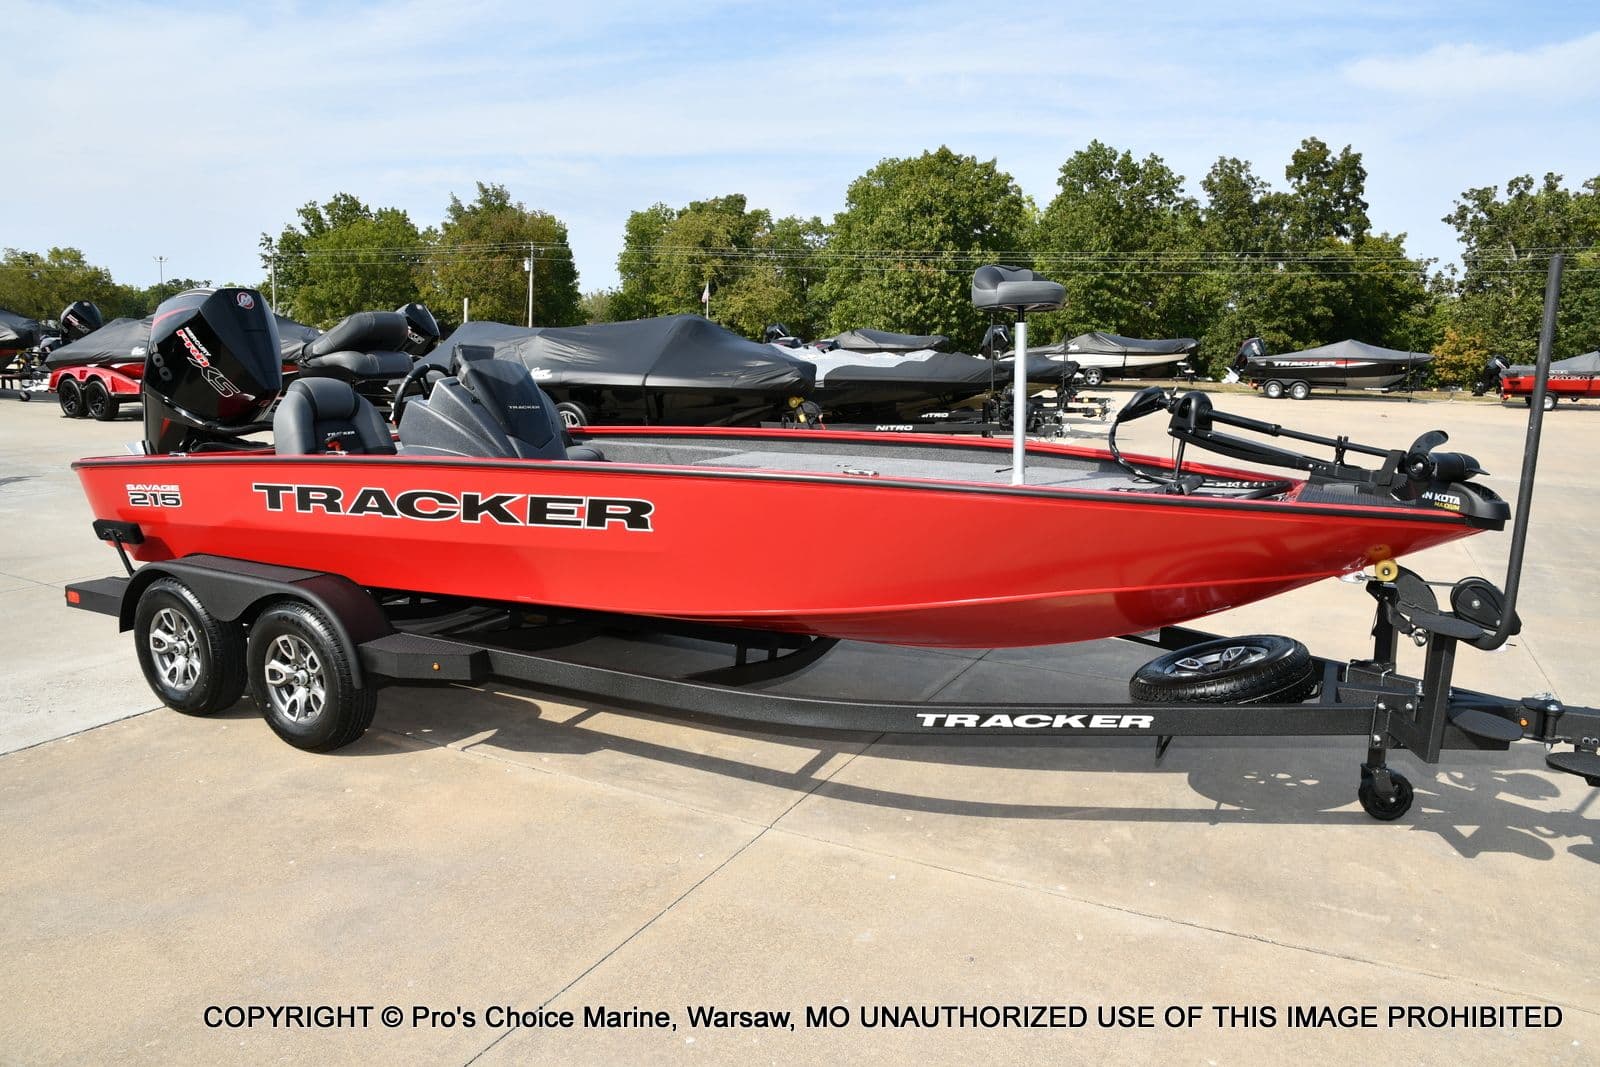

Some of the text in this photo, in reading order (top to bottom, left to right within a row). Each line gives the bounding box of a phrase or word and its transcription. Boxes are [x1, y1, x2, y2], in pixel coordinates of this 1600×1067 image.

[183, 326, 212, 357] MERCURY
[127, 490, 182, 507] 215
[252, 482, 653, 532] TRACKER
[1434, 492, 1460, 505] KOTA
[916, 713, 1154, 729] TRACKER
